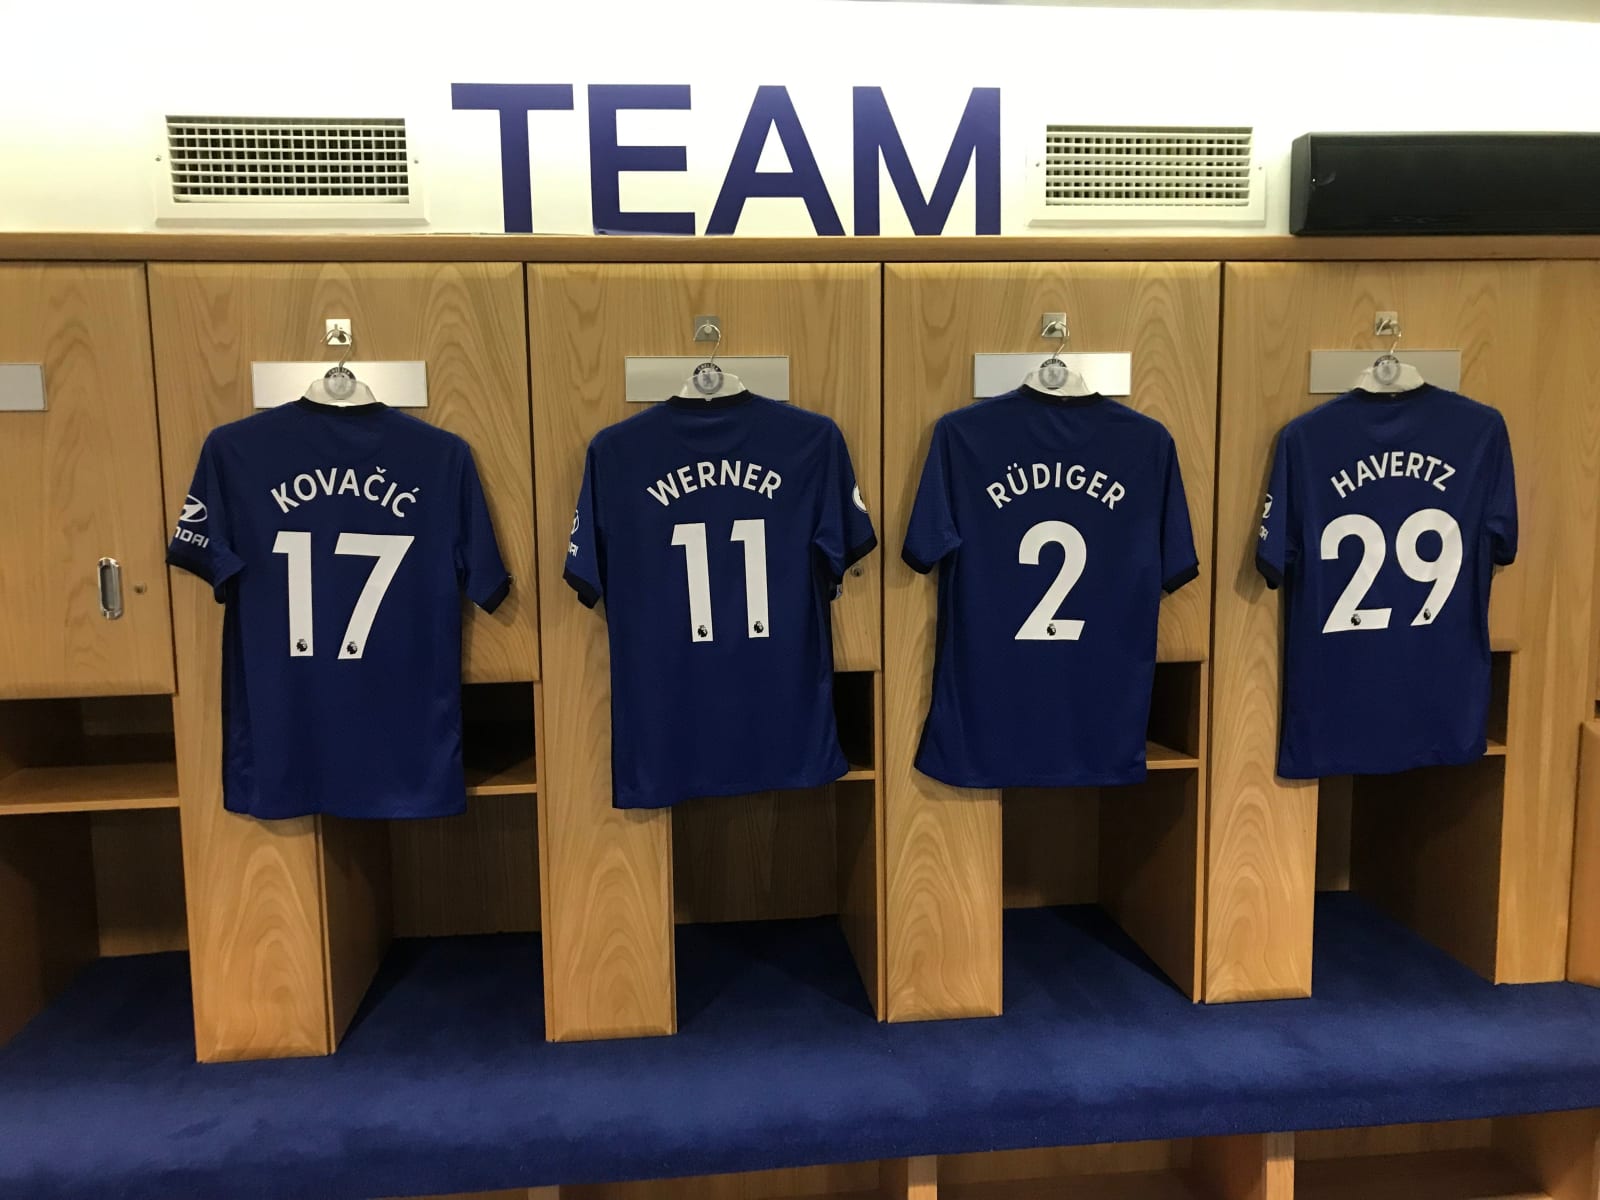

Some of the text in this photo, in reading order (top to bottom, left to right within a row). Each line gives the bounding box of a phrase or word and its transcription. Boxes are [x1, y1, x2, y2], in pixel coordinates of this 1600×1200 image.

[452, 83, 1001, 236] TEAM
[271, 467, 420, 517] KOVAČIĆ
[647, 460, 782, 506] WERNER
[986, 463, 1126, 510] RÜDIGER
[1331, 452, 1456, 498] HAVERTZ
[272, 531, 414, 659] 17
[671, 519, 769, 642] 11
[1015, 521, 1087, 640] 2
[1321, 509, 1462, 633] 29
